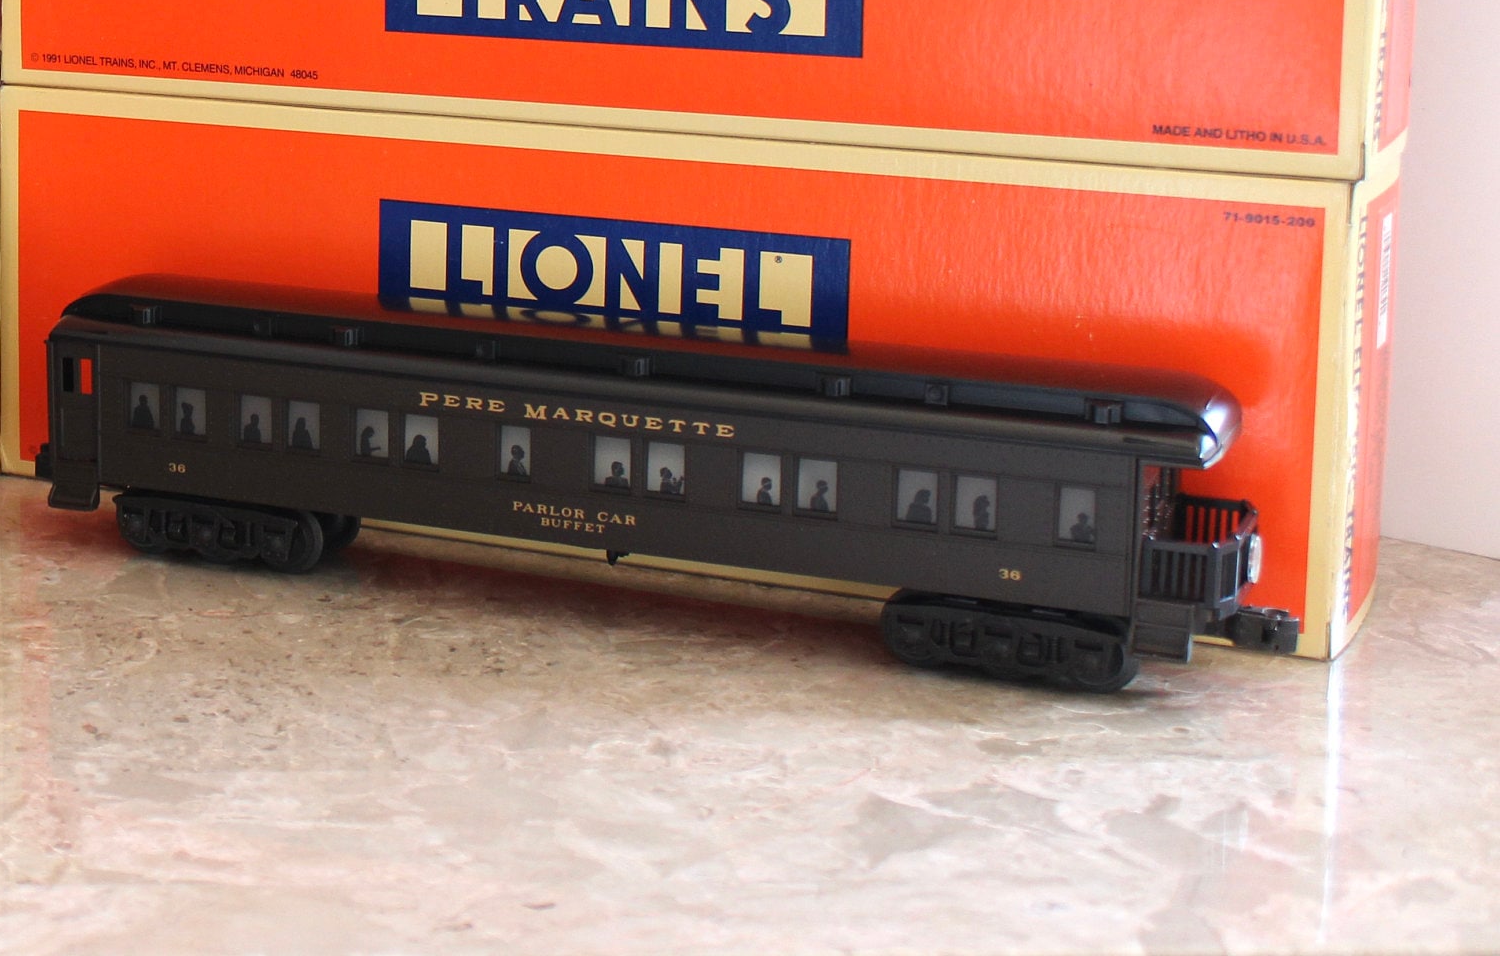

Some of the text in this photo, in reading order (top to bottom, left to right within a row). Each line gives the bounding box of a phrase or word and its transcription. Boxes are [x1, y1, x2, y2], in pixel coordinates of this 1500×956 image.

[42, 54, 61, 64] 1991
[64, 55, 97, 66] LIONEL
[100, 57, 137, 69] TRAINS,
[162, 61, 180, 71] MT.
[182, 62, 232, 75] CLEMENS,
[235, 66, 285, 78] MICHIGAN
[290, 69, 318, 80] 48045
[1152, 124, 1190, 137] MADE
[1194, 127, 1223, 139] AND
[1226, 129, 1267, 142] LITHO
[1270, 132, 1283, 143] IN
[1223, 211, 1315, 227] 71-9015-200
[428, 221, 798, 327] LIONEL
[419, 391, 736, 438] PERE MARQUETTE
[168, 463, 186, 474] 36
[512, 500, 637, 526] PARLOR CAR
[540, 517, 605, 534] BUFFET
[998, 569, 1022, 581] 36
